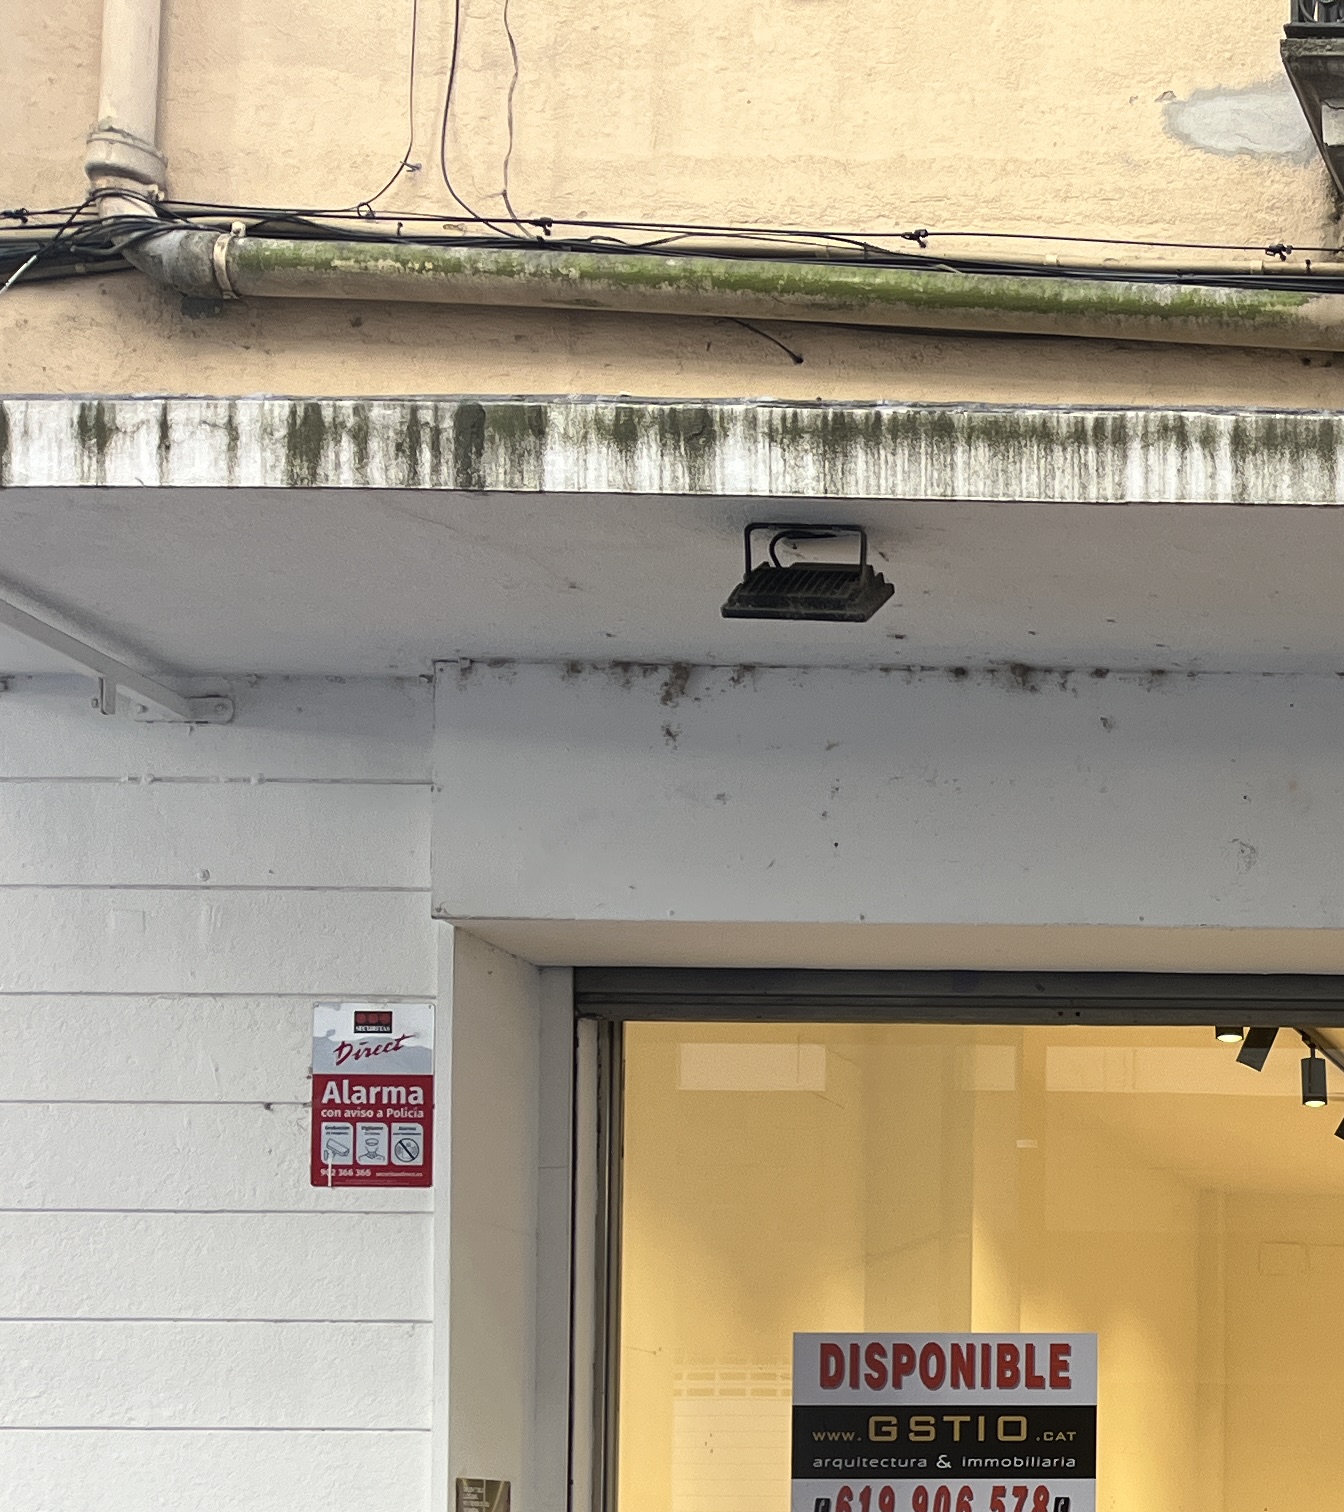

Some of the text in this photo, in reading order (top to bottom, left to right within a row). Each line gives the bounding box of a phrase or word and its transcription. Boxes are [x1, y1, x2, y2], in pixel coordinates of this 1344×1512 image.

[333, 1033, 417, 1066] Direct
[321, 1079, 424, 1105] Alarma
[321, 1109, 342, 1118] con
[344, 1107, 374, 1118] aviso
[376, 1109, 384, 1118] a
[819, 1342, 1072, 1391] DISPONIBLE
[812, 1454, 1076, 1470] arquitectura & immobiliaria
